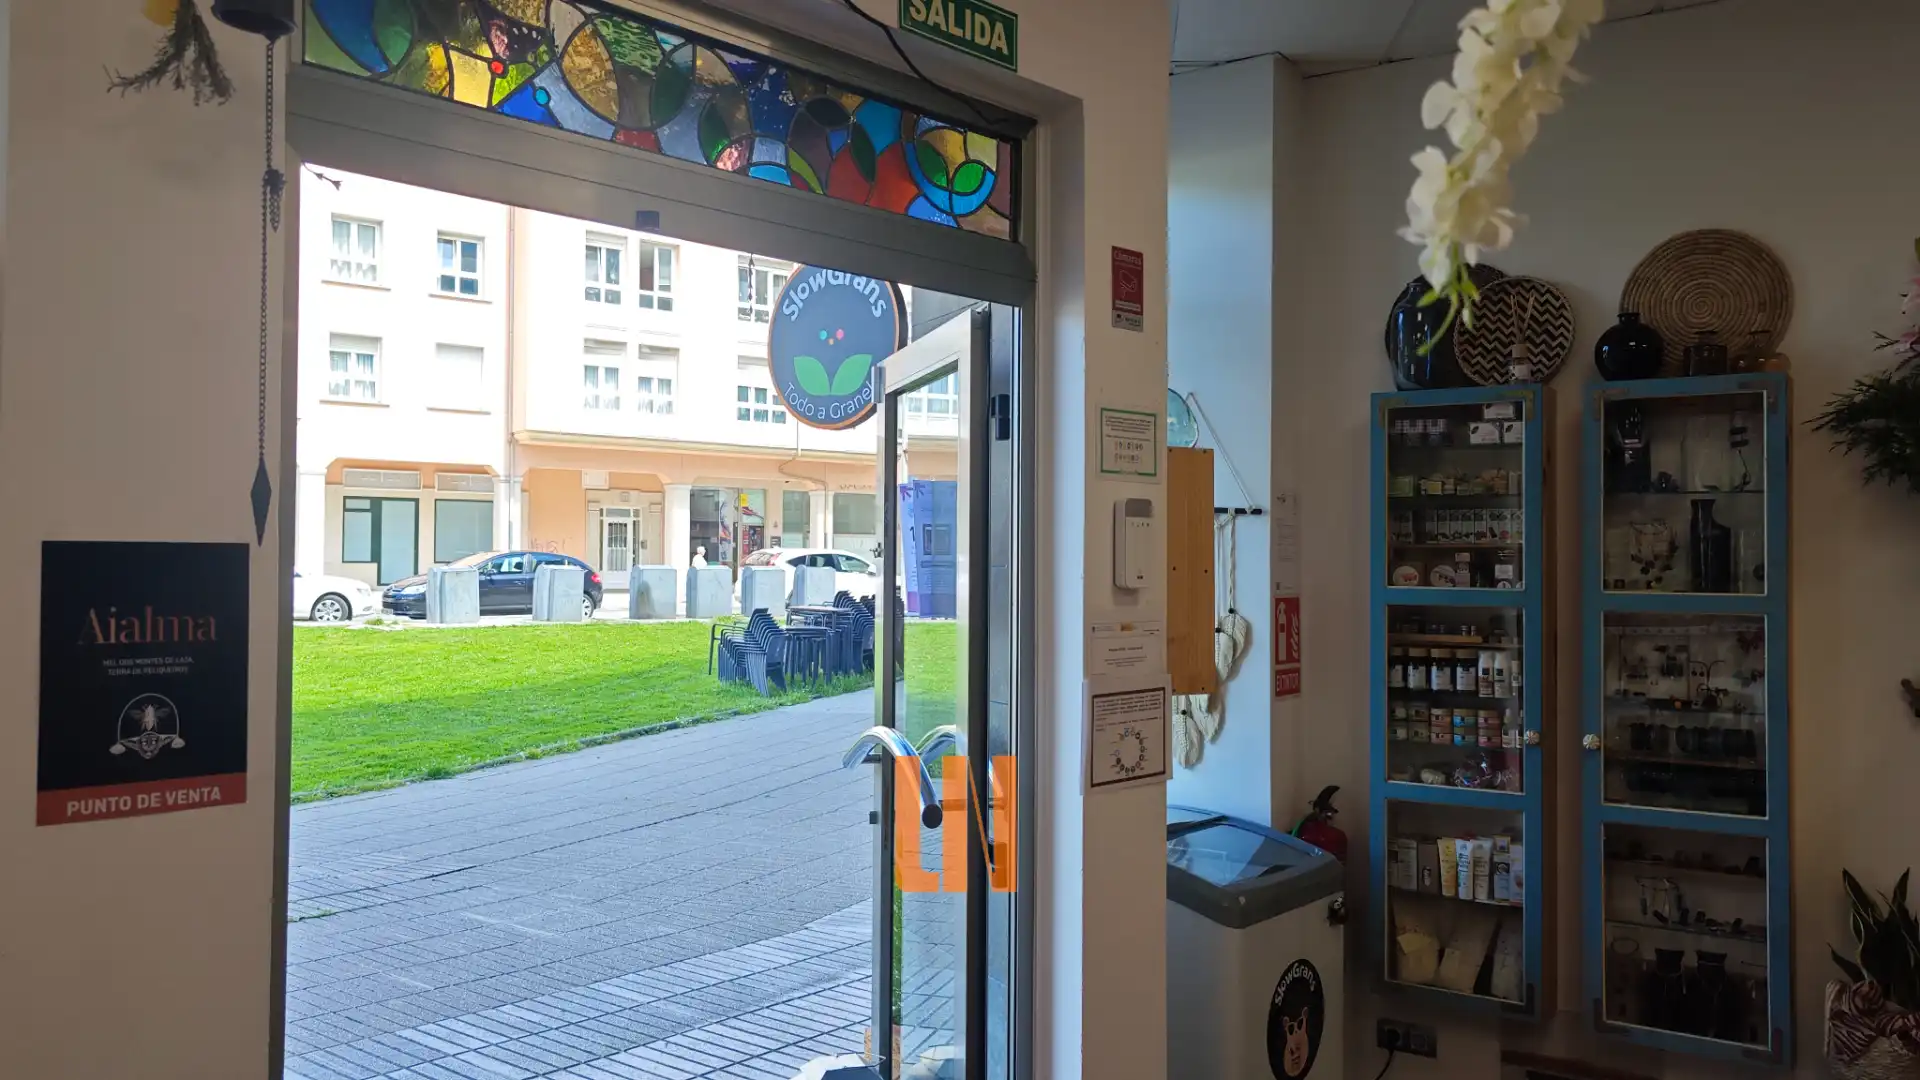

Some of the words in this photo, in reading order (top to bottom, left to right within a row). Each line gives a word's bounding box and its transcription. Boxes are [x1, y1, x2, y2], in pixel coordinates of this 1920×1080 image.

[909, 0, 1009, 56] SALIDA
[782, 268, 887, 322] SlowGrans
[784, 382, 815, 416] Todo
[817, 405, 826, 419] a
[76, 604, 217, 645] Aialma
[67, 795, 133, 817] PUNTO
[137, 792, 162, 809] DE
[165, 786, 221, 806] VENTA
[1275, 962, 1316, 1006] SlowGrans
